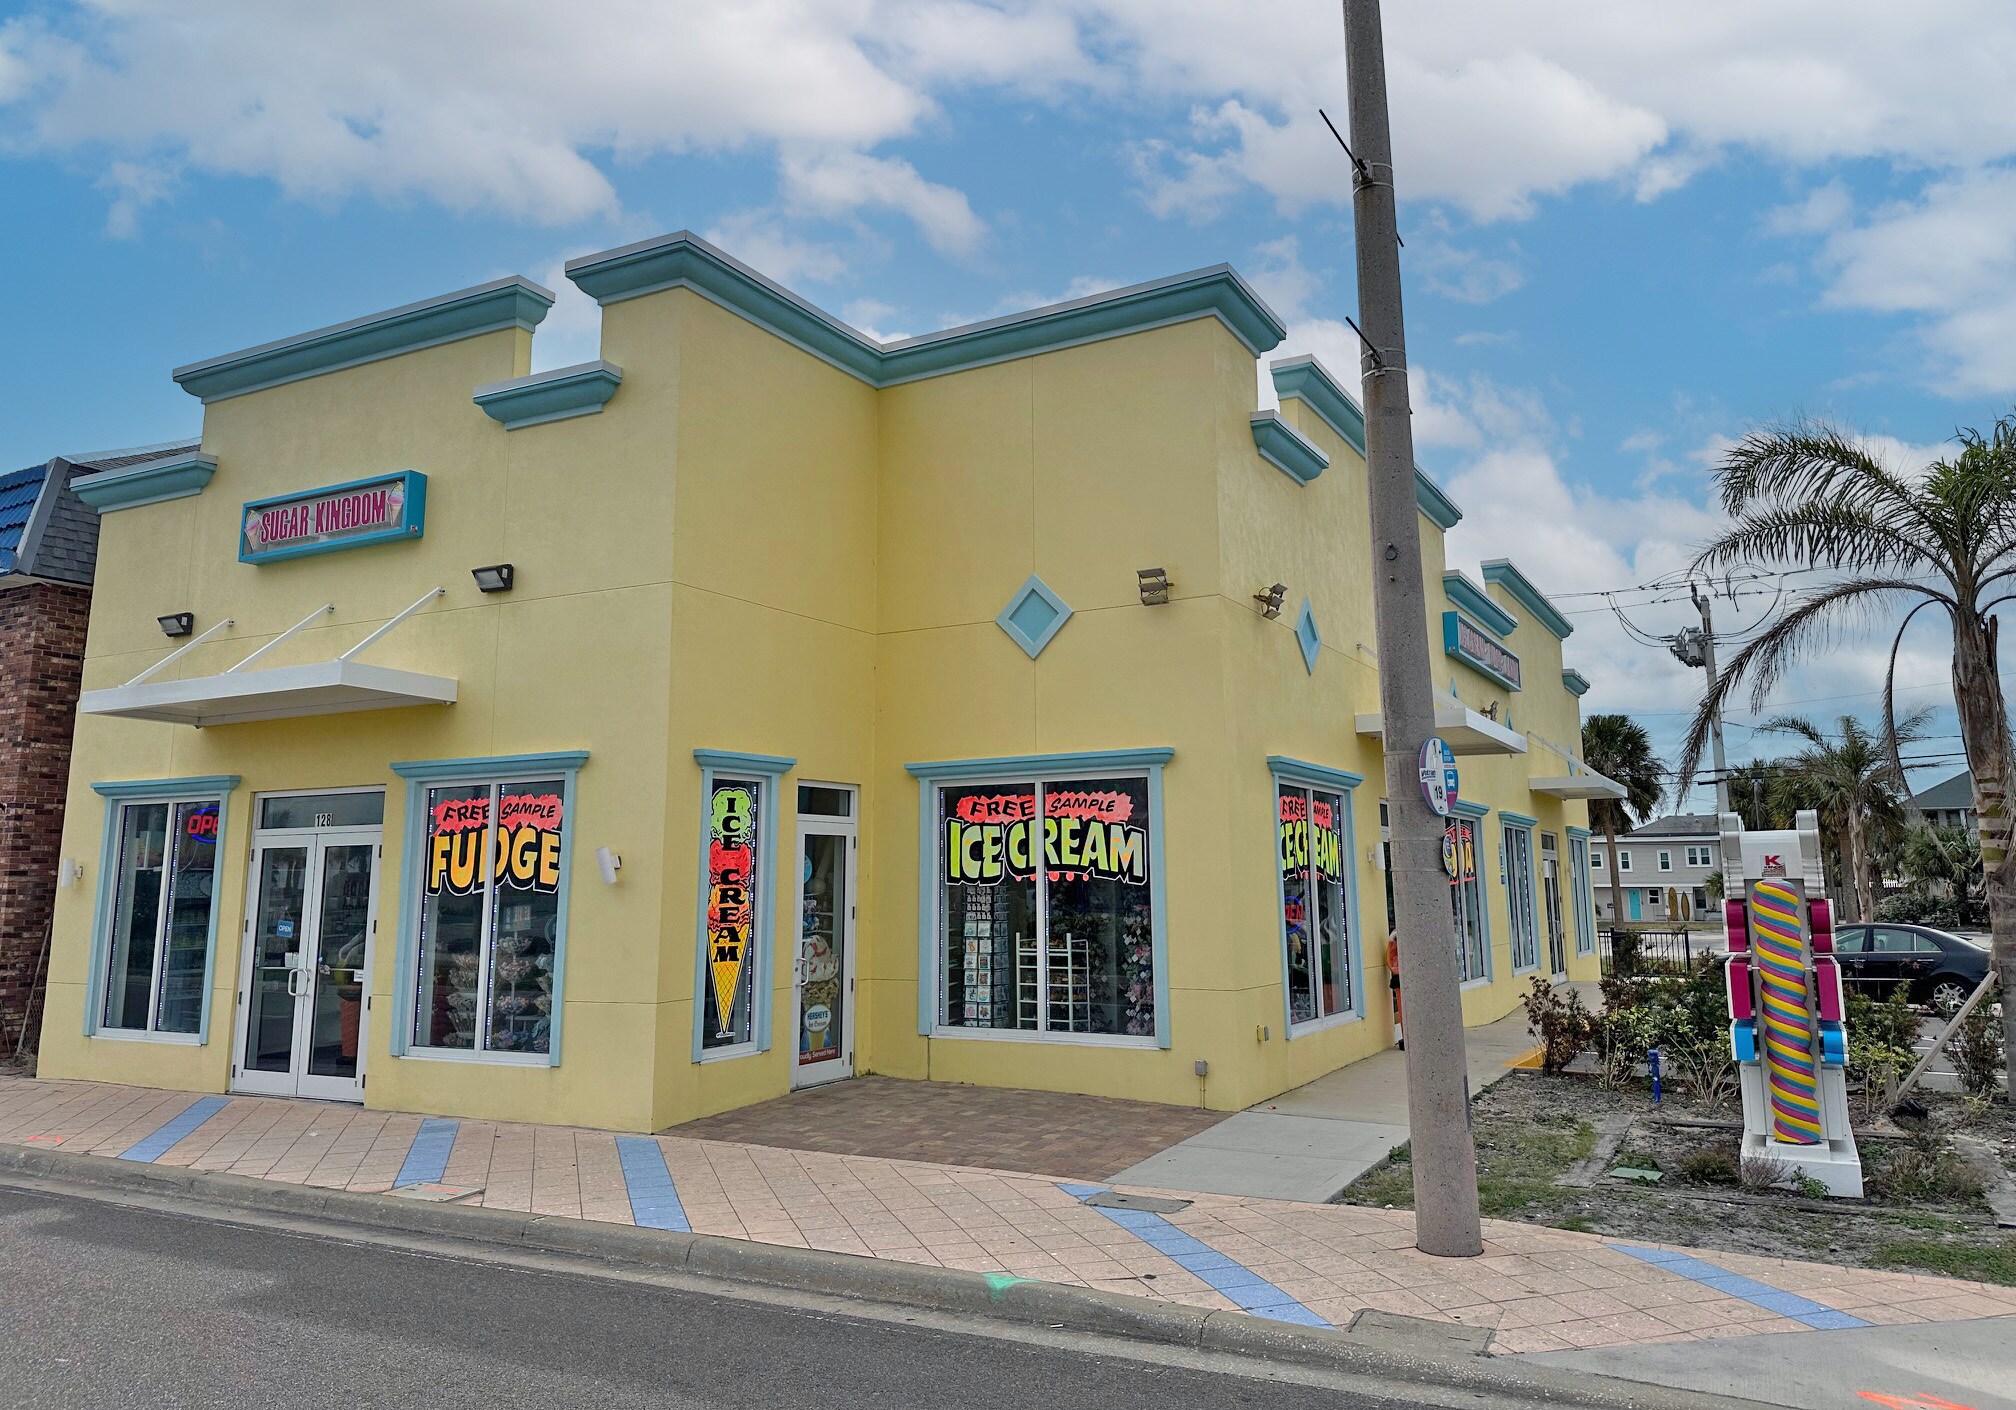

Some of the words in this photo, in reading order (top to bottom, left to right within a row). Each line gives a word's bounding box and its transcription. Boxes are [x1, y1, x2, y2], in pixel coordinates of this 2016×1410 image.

[260, 505, 310, 543] SUGAR
[315, 490, 387, 533] KINGDOM
[1434, 785, 1443, 799] 19
[443, 805, 491, 822] FREE
[501, 803, 556, 819] SAMPLE
[970, 800, 1034, 817] FREE
[1049, 797, 1116, 813] SAMPLE
[1281, 798, 1306, 817] FREE
[316, 814, 332, 827] 128
[722, 796, 742, 851] ICE
[428, 825, 561, 891] FUDGE
[948, 819, 1003, 882] ICE
[1007, 818, 1145, 880] CREAM
[712, 868, 746, 963] CREAM
[278, 924, 292, 932] OPEN
